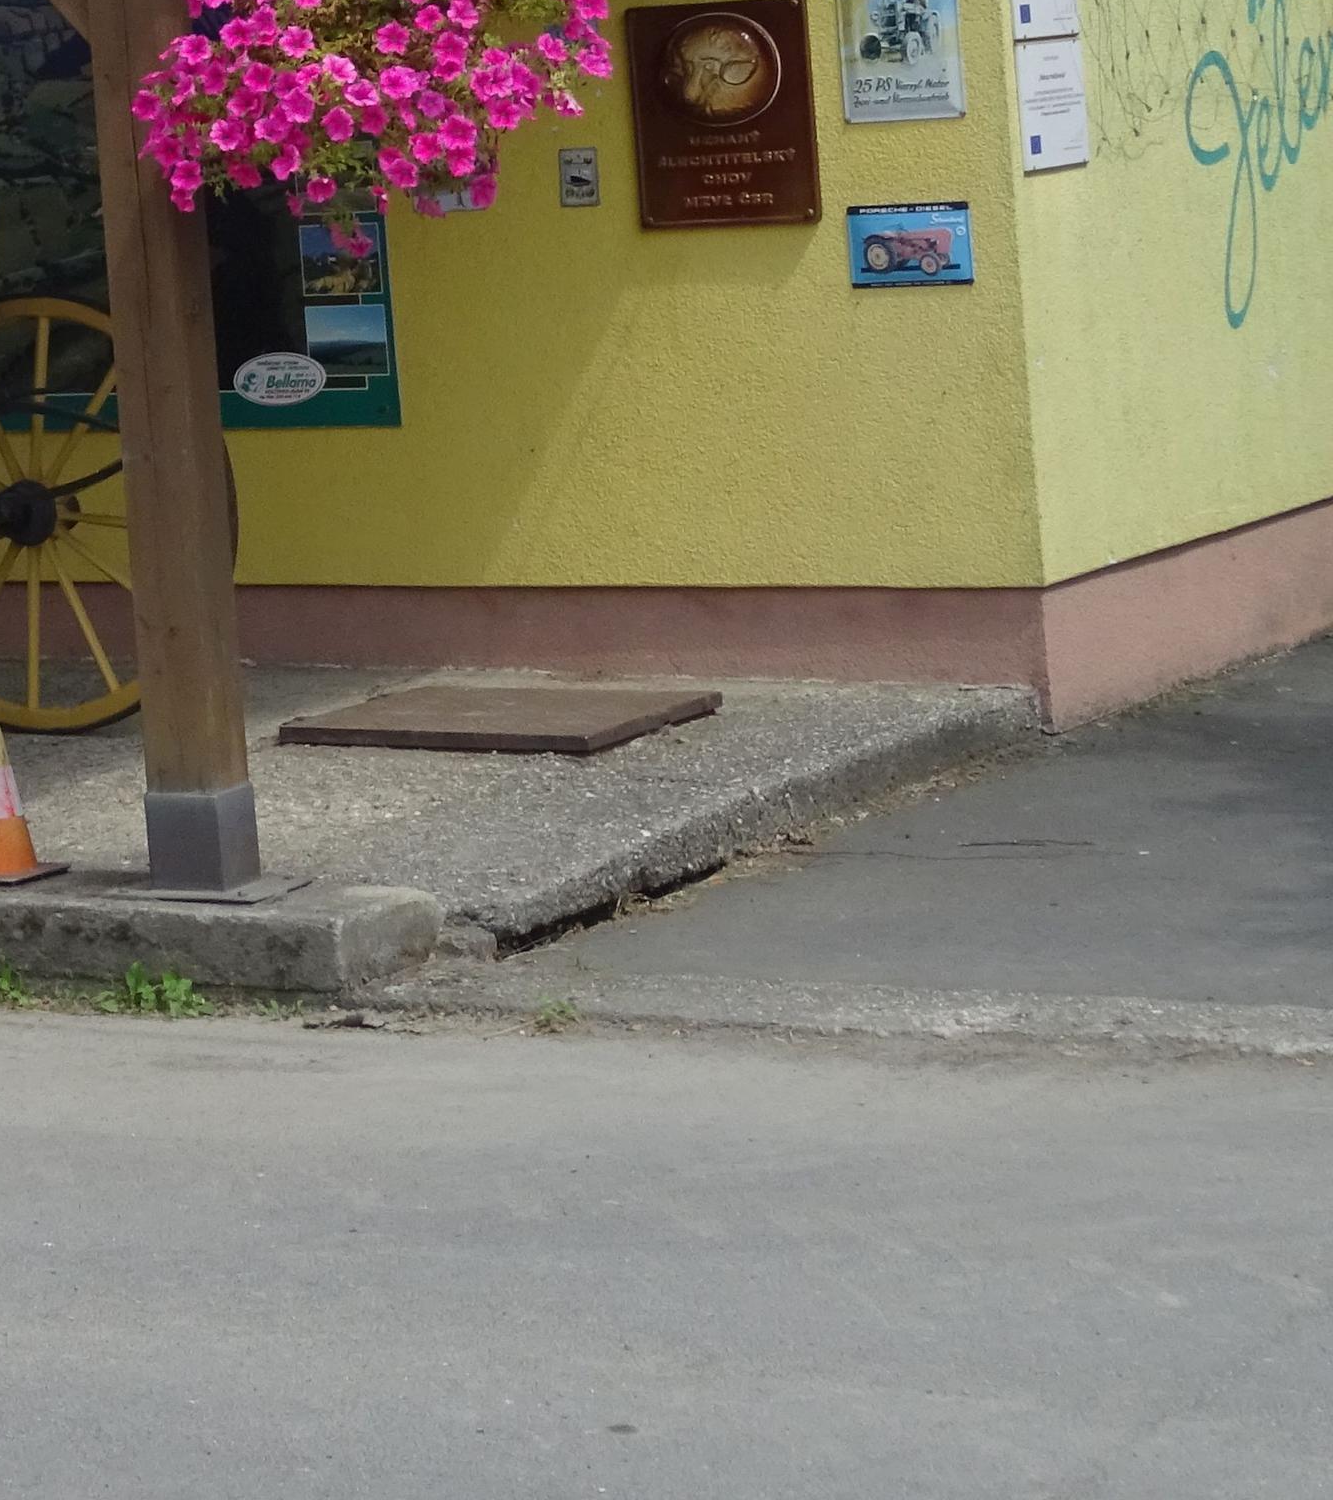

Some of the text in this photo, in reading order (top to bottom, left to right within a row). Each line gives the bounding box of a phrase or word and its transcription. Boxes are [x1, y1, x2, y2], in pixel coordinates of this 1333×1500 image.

[853, 78, 873, 94] 25
[875, 76, 893, 92] PS
[703, 171, 753, 185] CHOV
